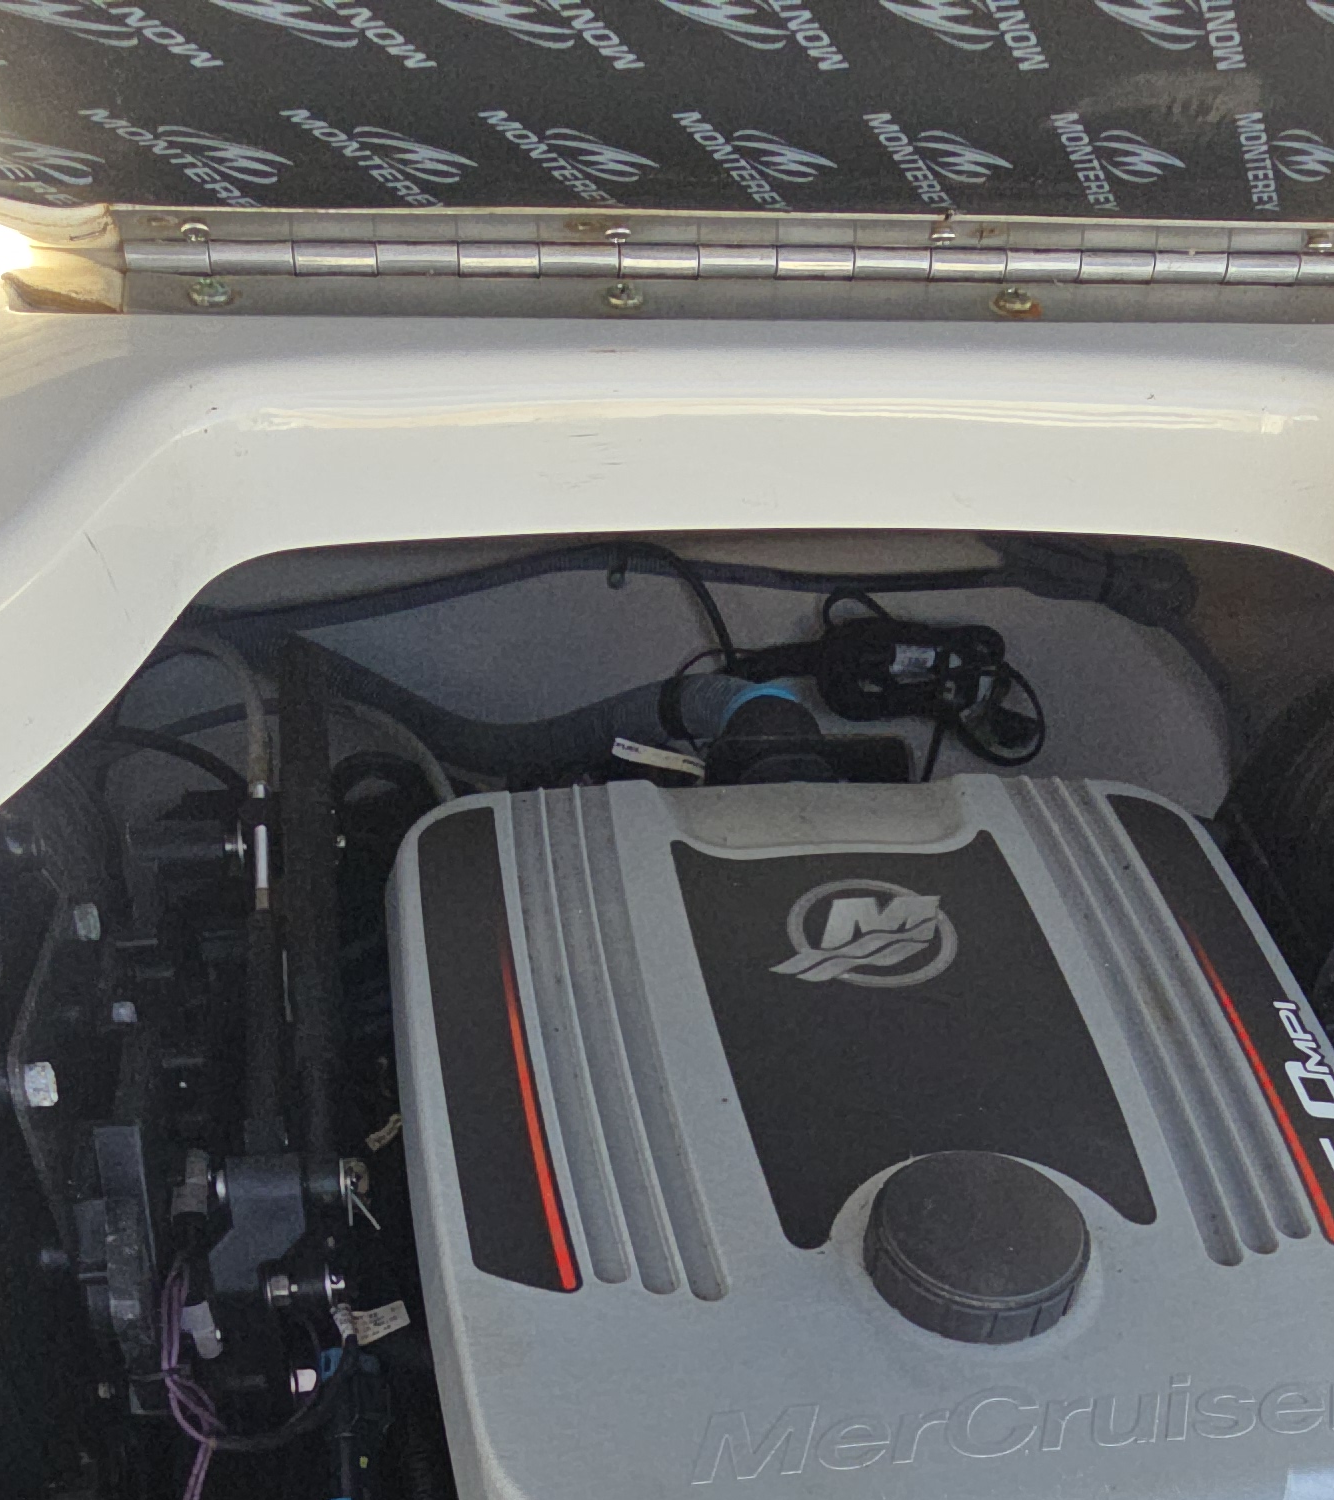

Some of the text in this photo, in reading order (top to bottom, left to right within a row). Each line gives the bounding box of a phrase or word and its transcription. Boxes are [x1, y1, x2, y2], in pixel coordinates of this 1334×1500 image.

[862, 112, 956, 209] MONTEREY
[1050, 112, 1119, 211] MONTEREY
[1234, 112, 1279, 212] MONTEREY
